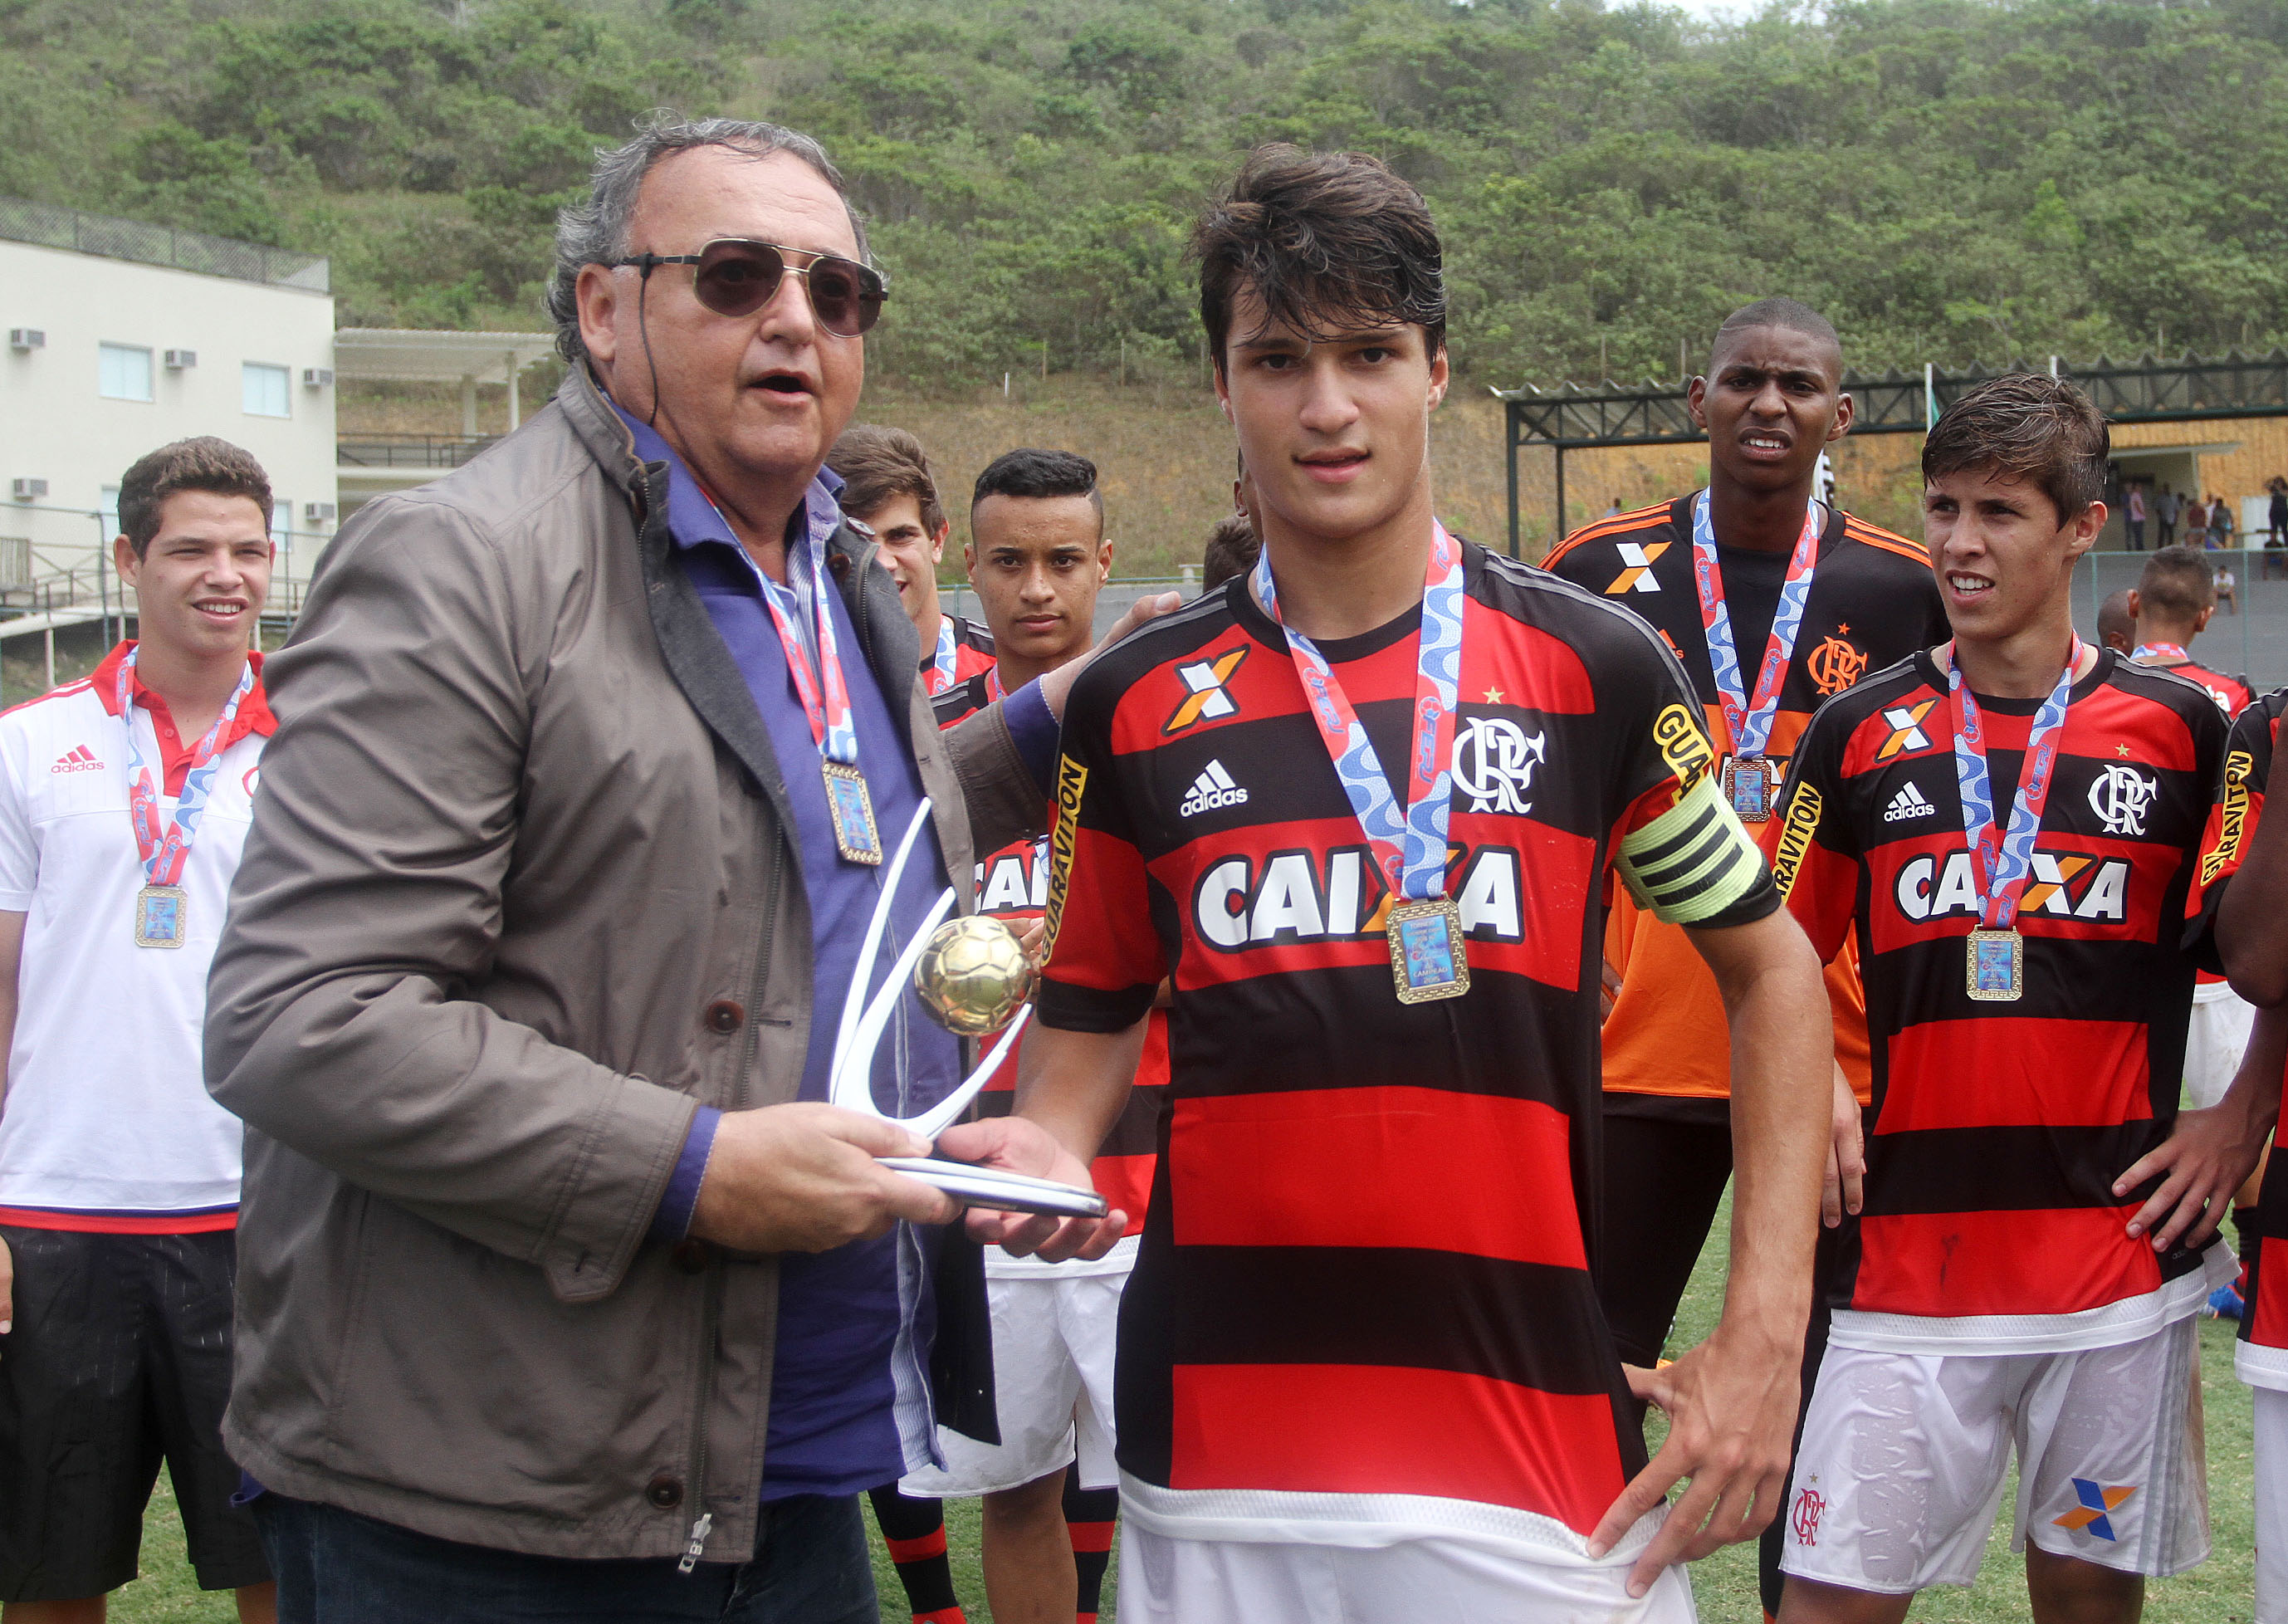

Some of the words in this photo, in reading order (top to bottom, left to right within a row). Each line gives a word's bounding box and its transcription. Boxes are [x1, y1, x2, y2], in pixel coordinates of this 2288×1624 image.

[51, 760, 105, 774] adidas
[1418, 714, 1438, 785] FERJ
[1180, 787, 1249, 818] adidas
[1884, 803, 1936, 822] adidas
[1041, 761, 1085, 961] GUARAVITON
[1897, 852, 2128, 920] CAXA
[1197, 849, 1519, 947] CAIA
